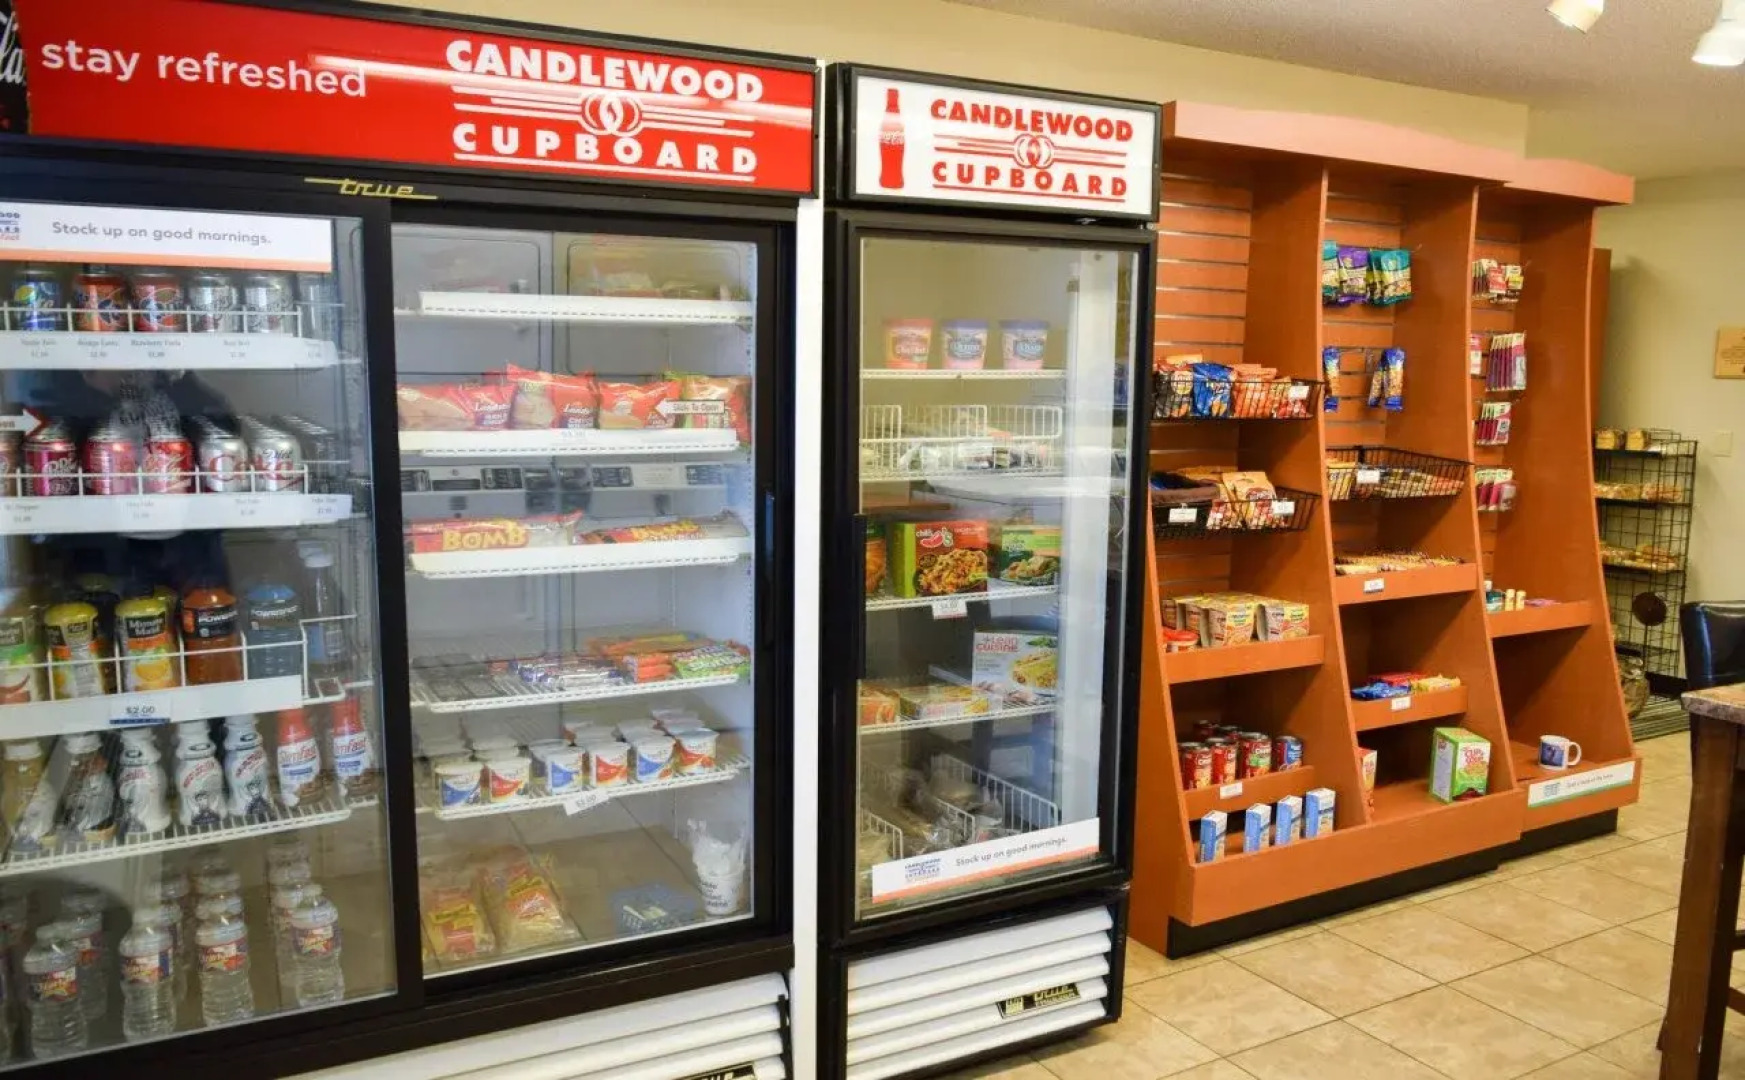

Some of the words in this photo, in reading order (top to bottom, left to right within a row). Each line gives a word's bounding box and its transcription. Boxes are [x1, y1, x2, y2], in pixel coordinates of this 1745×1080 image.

[42, 40, 140, 82] stay
[158, 53, 366, 98] refreshed
[446, 39, 763, 102] CANDLEWOOD
[930, 98, 1133, 142] CANDLEWOOD
[452, 122, 757, 174] CUPBOARD
[932, 161, 1128, 197] CUPBOARD
[52, 221, 97, 236] Stock
[103, 224, 122, 241] up
[129, 226, 147, 238] on
[154, 226, 193, 245] good
[198, 229, 272, 247] mornings.
[442, 519, 525, 550] BOMB
[956, 854, 981, 867] Stock
[981, 854, 992, 864] up
[1006, 844, 1028, 857] good
